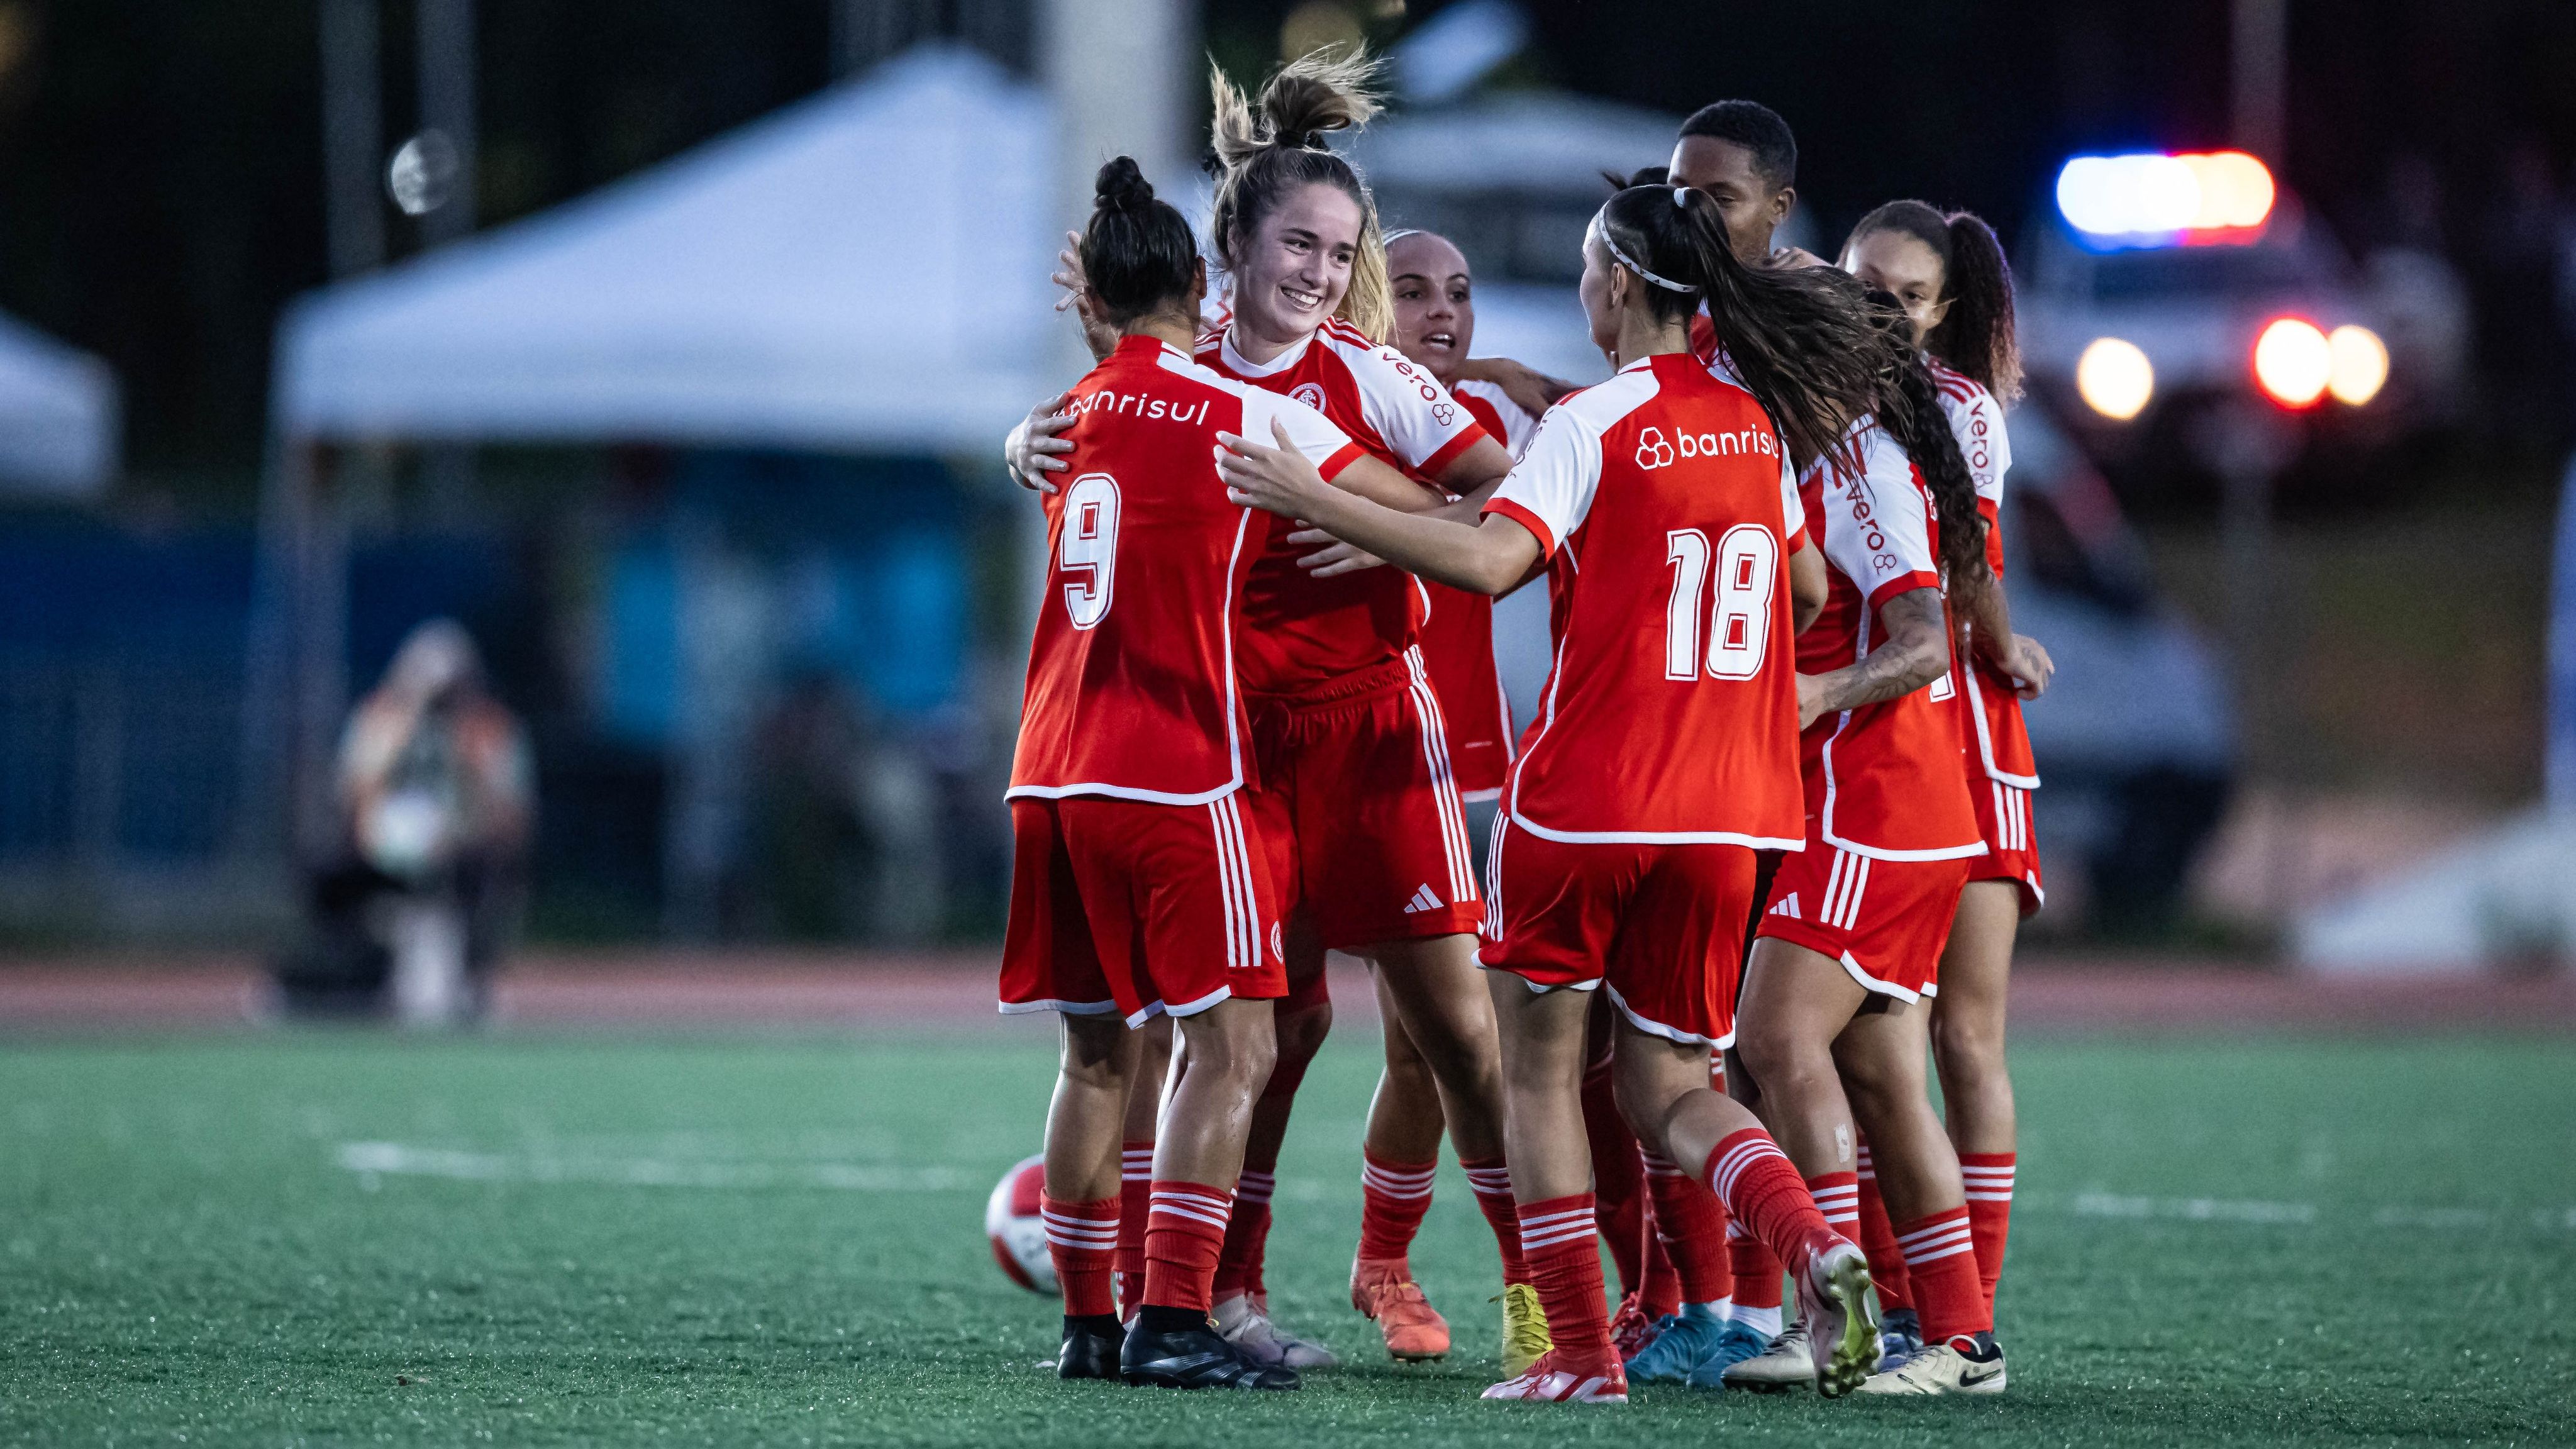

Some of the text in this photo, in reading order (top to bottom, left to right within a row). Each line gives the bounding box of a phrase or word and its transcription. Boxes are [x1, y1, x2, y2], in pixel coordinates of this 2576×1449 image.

[1069, 390, 1209, 425] banrisul
[1383, 352, 1437, 401] vero
[1677, 423, 1779, 459] banrisu
[1970, 401, 1988, 468] vero
[1846, 487, 1884, 551] vero
[1060, 473, 1121, 630] 9
[1665, 523, 1778, 680] 18
